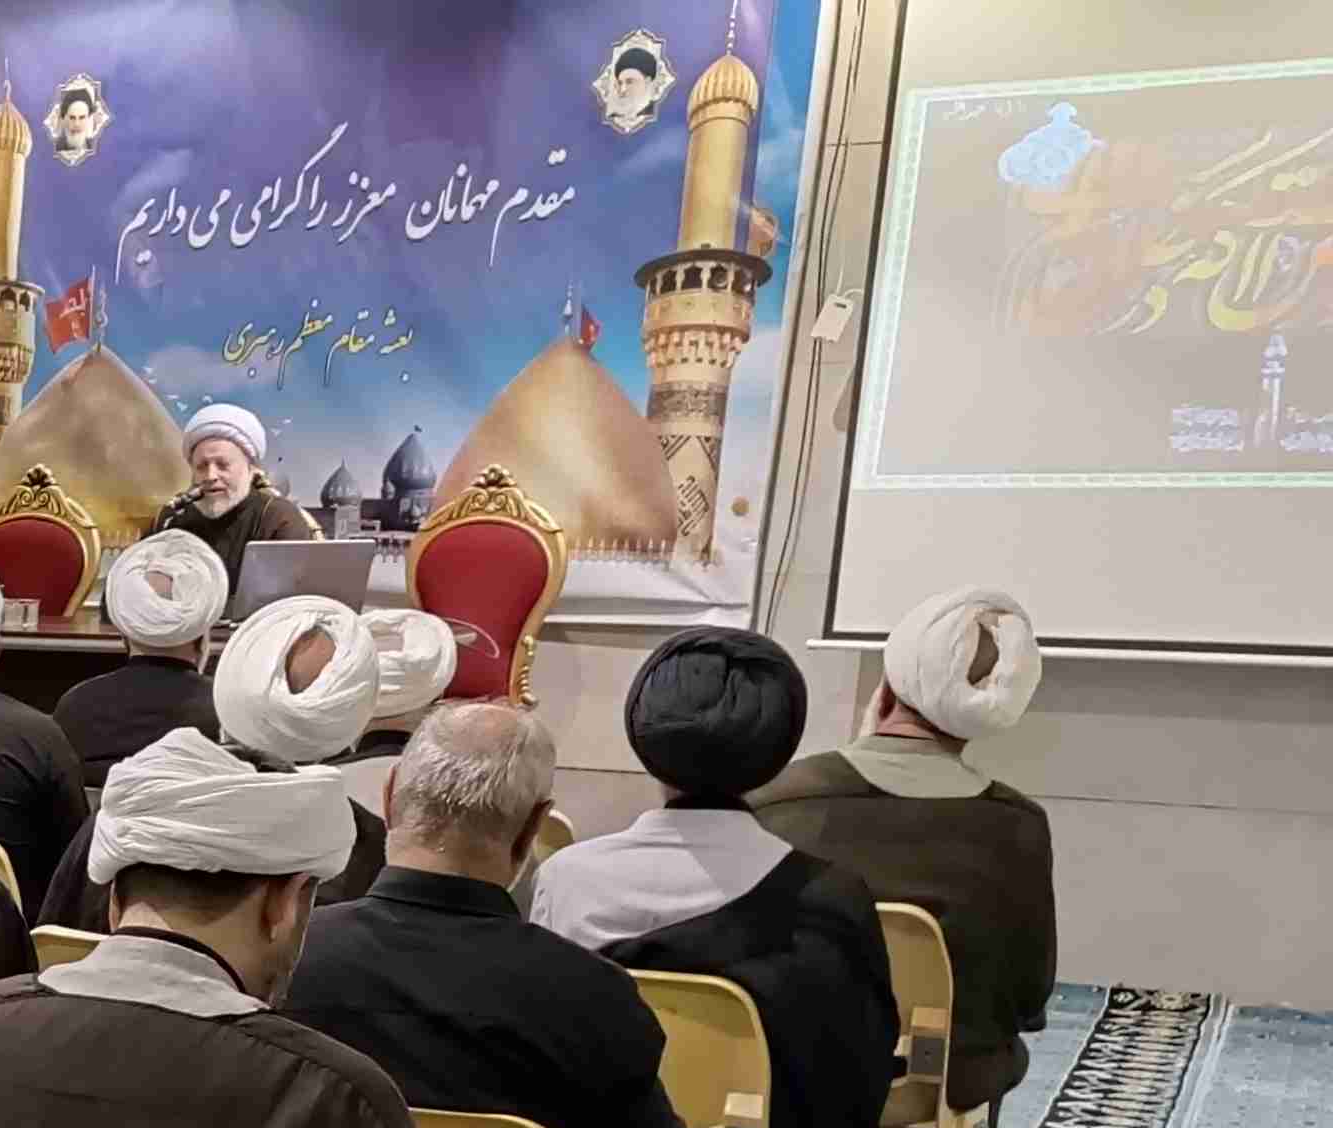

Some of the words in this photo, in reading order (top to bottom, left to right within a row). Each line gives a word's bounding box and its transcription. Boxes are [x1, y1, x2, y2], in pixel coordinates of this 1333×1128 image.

[306, 172, 328, 229] را
[333, 171, 397, 242] معزز
[404, 164, 500, 240] مهمانان
[489, 149, 576, 267] مقدم
[223, 321, 285, 378] رهبری
[276, 299, 334, 390] معظم
[323, 310, 375, 387] مقام
[380, 309, 414, 382] بعثه
